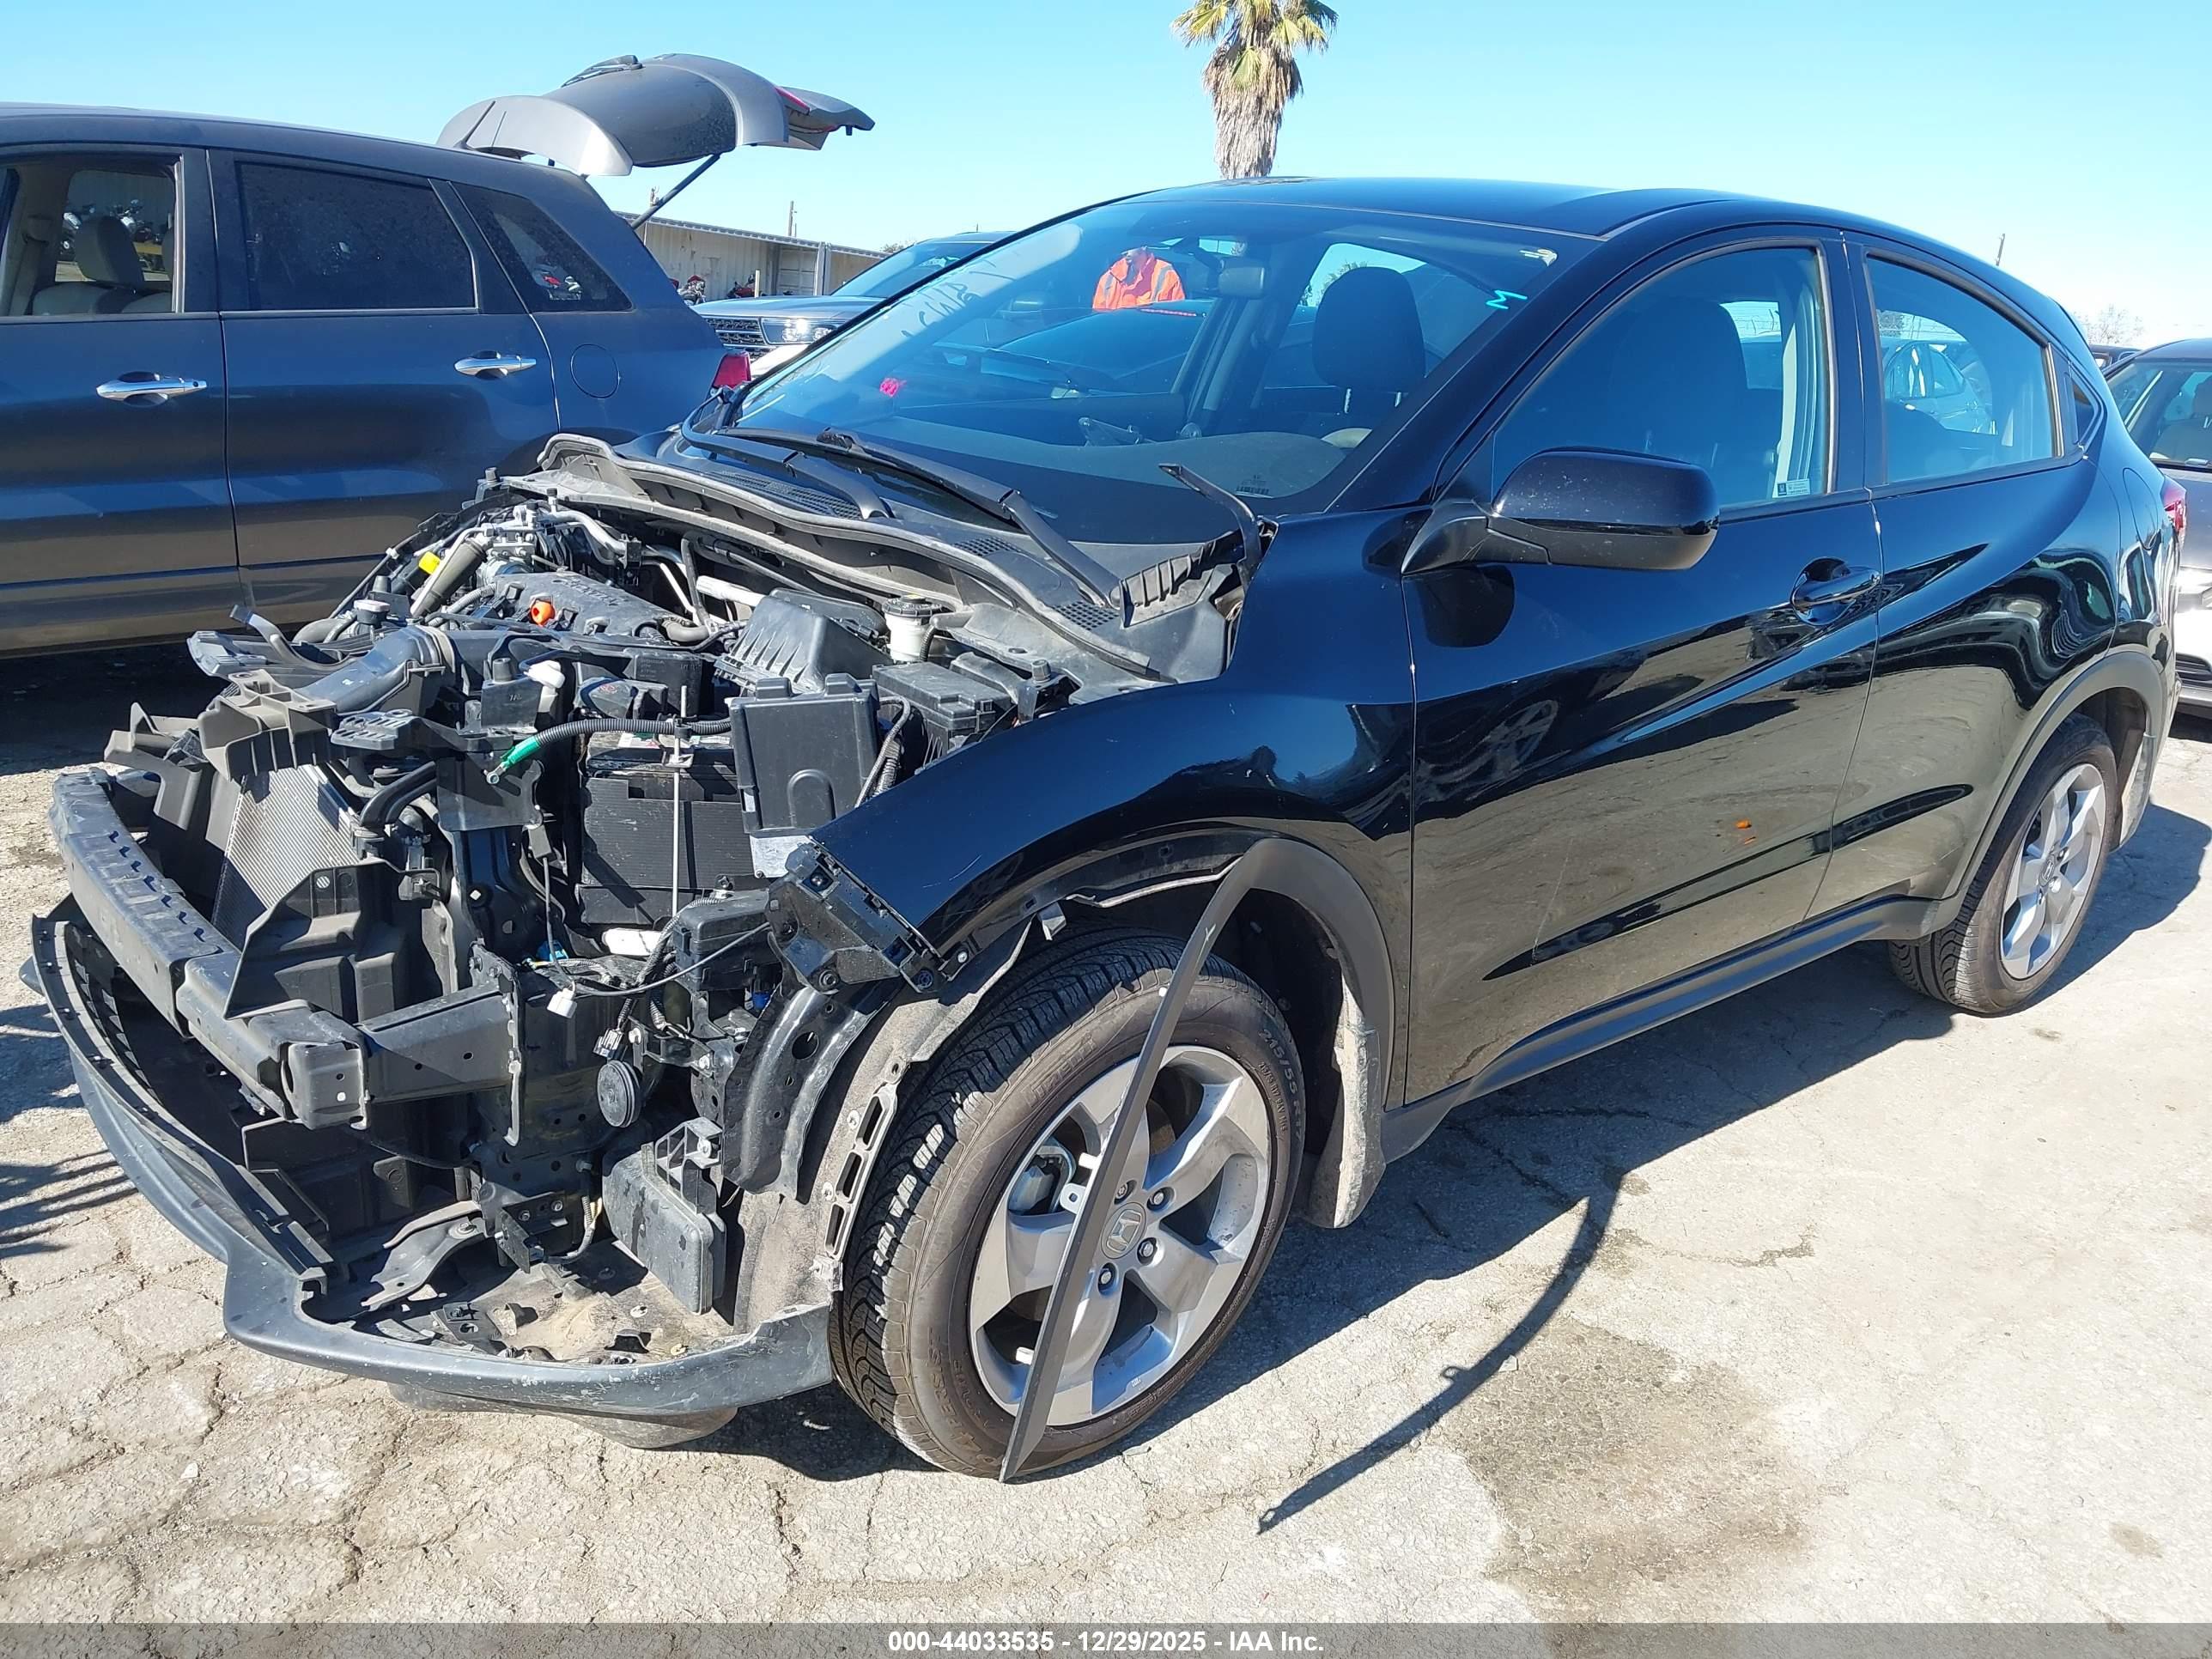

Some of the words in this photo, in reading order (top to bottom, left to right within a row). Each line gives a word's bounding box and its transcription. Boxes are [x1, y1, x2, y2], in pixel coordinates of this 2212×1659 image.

[1020, 1030, 1097, 1108] PIRELLI
[1259, 1029, 1297, 1095] 215/55
[1293, 1100, 1303, 1142] R17
